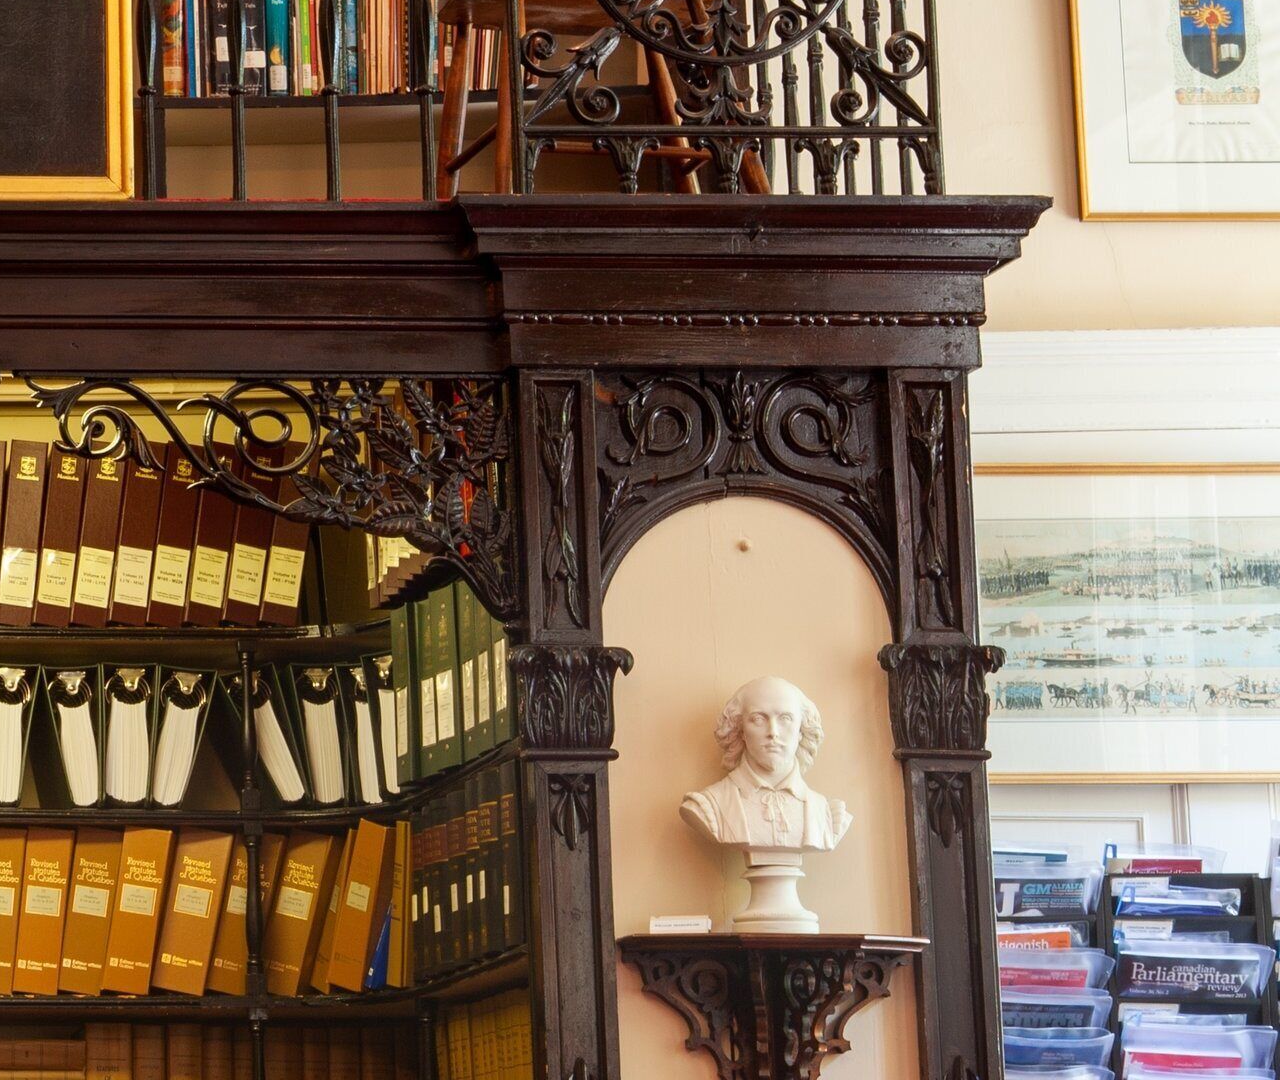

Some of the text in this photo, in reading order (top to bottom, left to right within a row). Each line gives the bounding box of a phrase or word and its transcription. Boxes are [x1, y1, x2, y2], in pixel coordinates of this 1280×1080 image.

[1023, 884, 1052, 895] GM
[999, 938, 1050, 950] tigonish
[1171, 964, 1216, 973] canadian
[1131, 962, 1249, 990] Parliamentary
[1207, 983, 1239, 992] review
